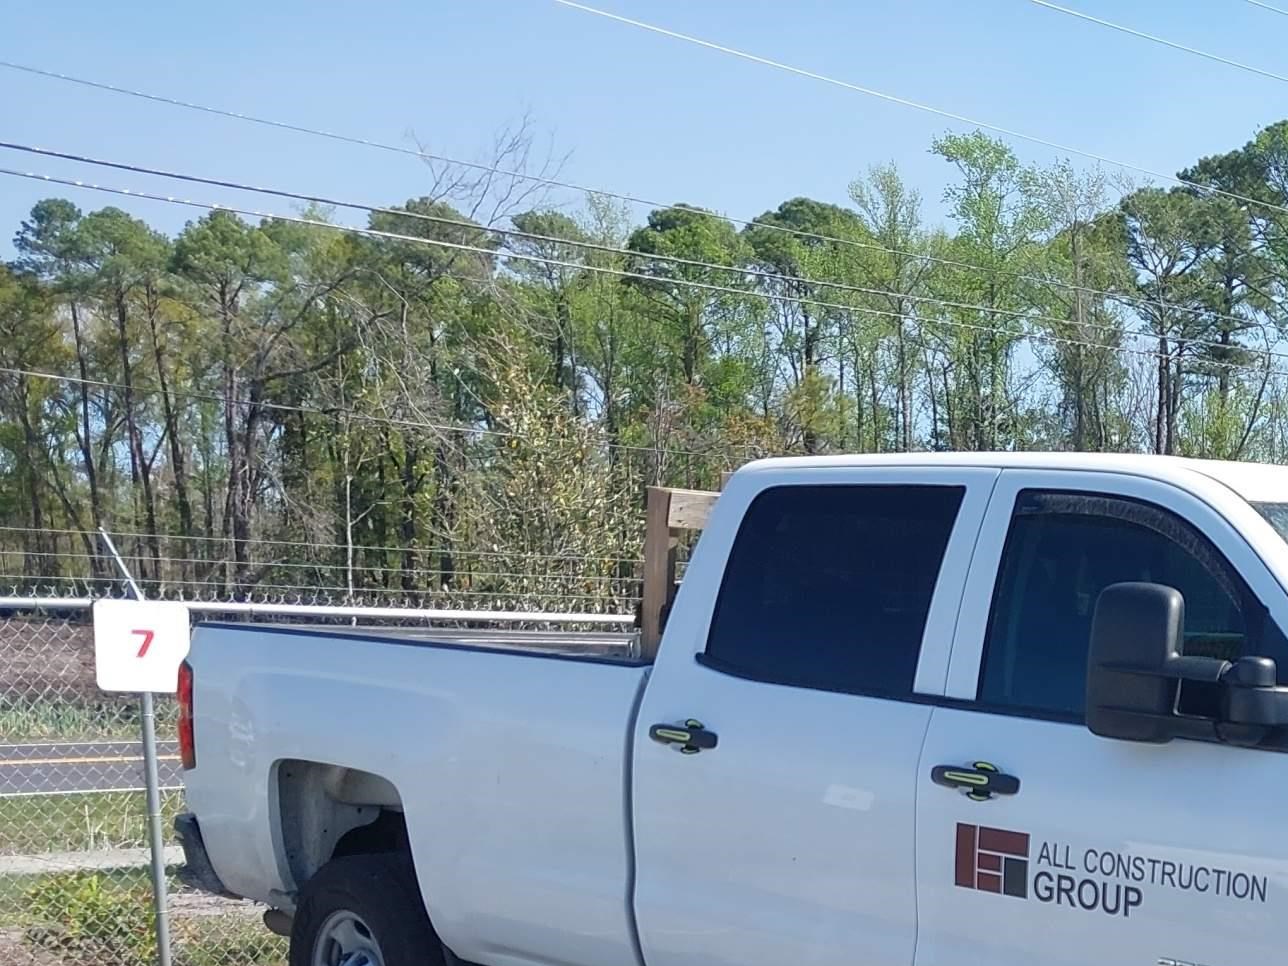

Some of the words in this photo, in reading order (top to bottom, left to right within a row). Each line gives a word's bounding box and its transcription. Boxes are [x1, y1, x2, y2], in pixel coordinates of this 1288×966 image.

[131, 629, 154, 658] 7
[1033, 871, 1144, 917] GROUP
[1037, 841, 1076, 870] ALL
[1083, 849, 1268, 902] CONSTRUCTION
